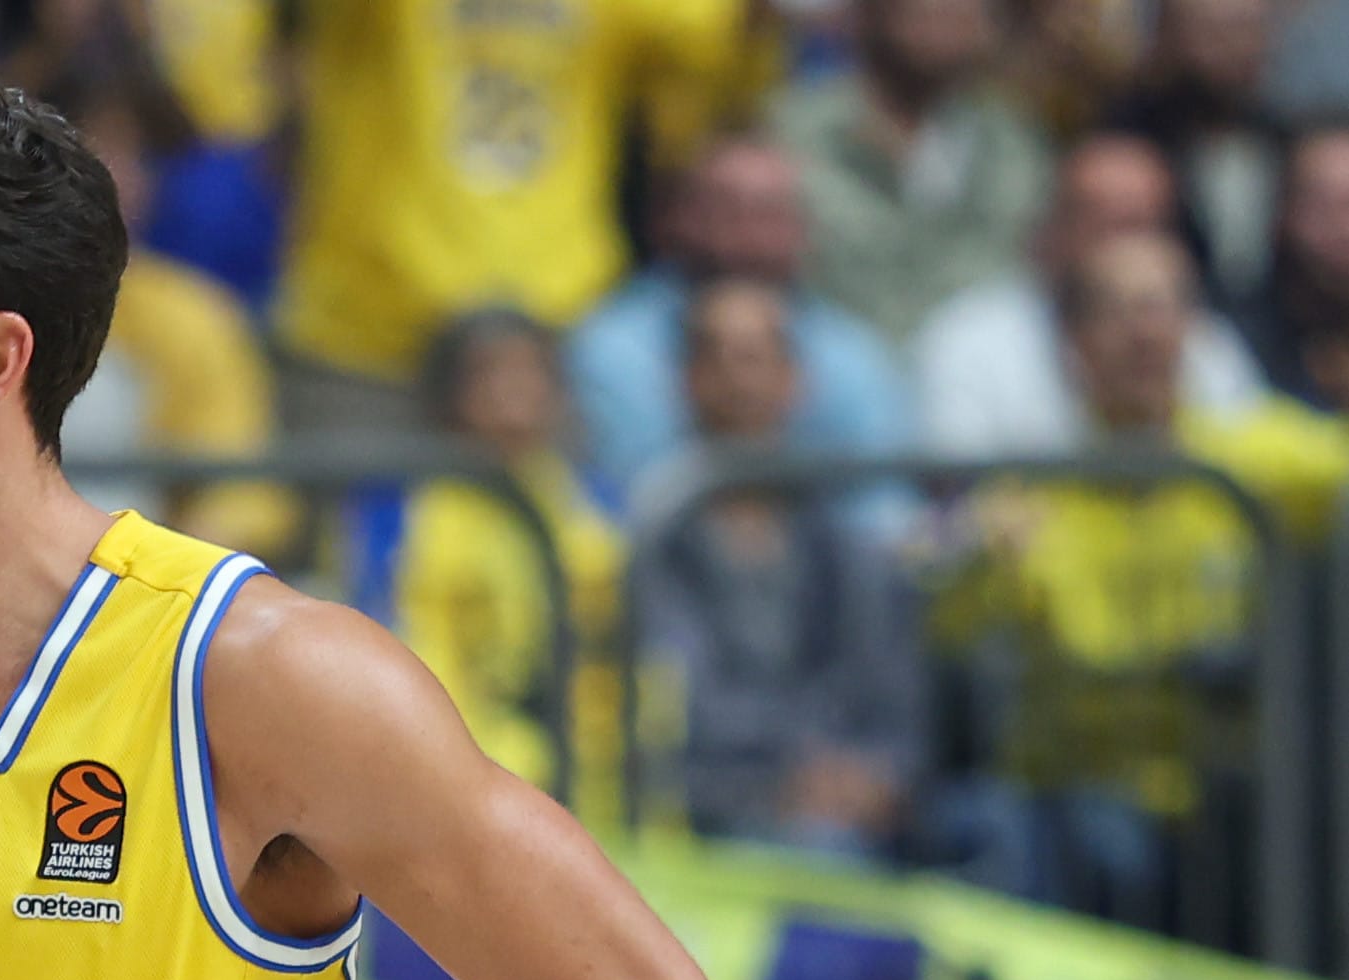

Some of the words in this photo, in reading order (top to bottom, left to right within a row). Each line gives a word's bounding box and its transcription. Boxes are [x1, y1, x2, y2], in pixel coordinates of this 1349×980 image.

[50, 843, 115, 857] TURKISH
[47, 856, 112, 870] AIRLINES
[43, 867, 110, 880] EuroLeague
[16, 896, 120, 921] oneteam
